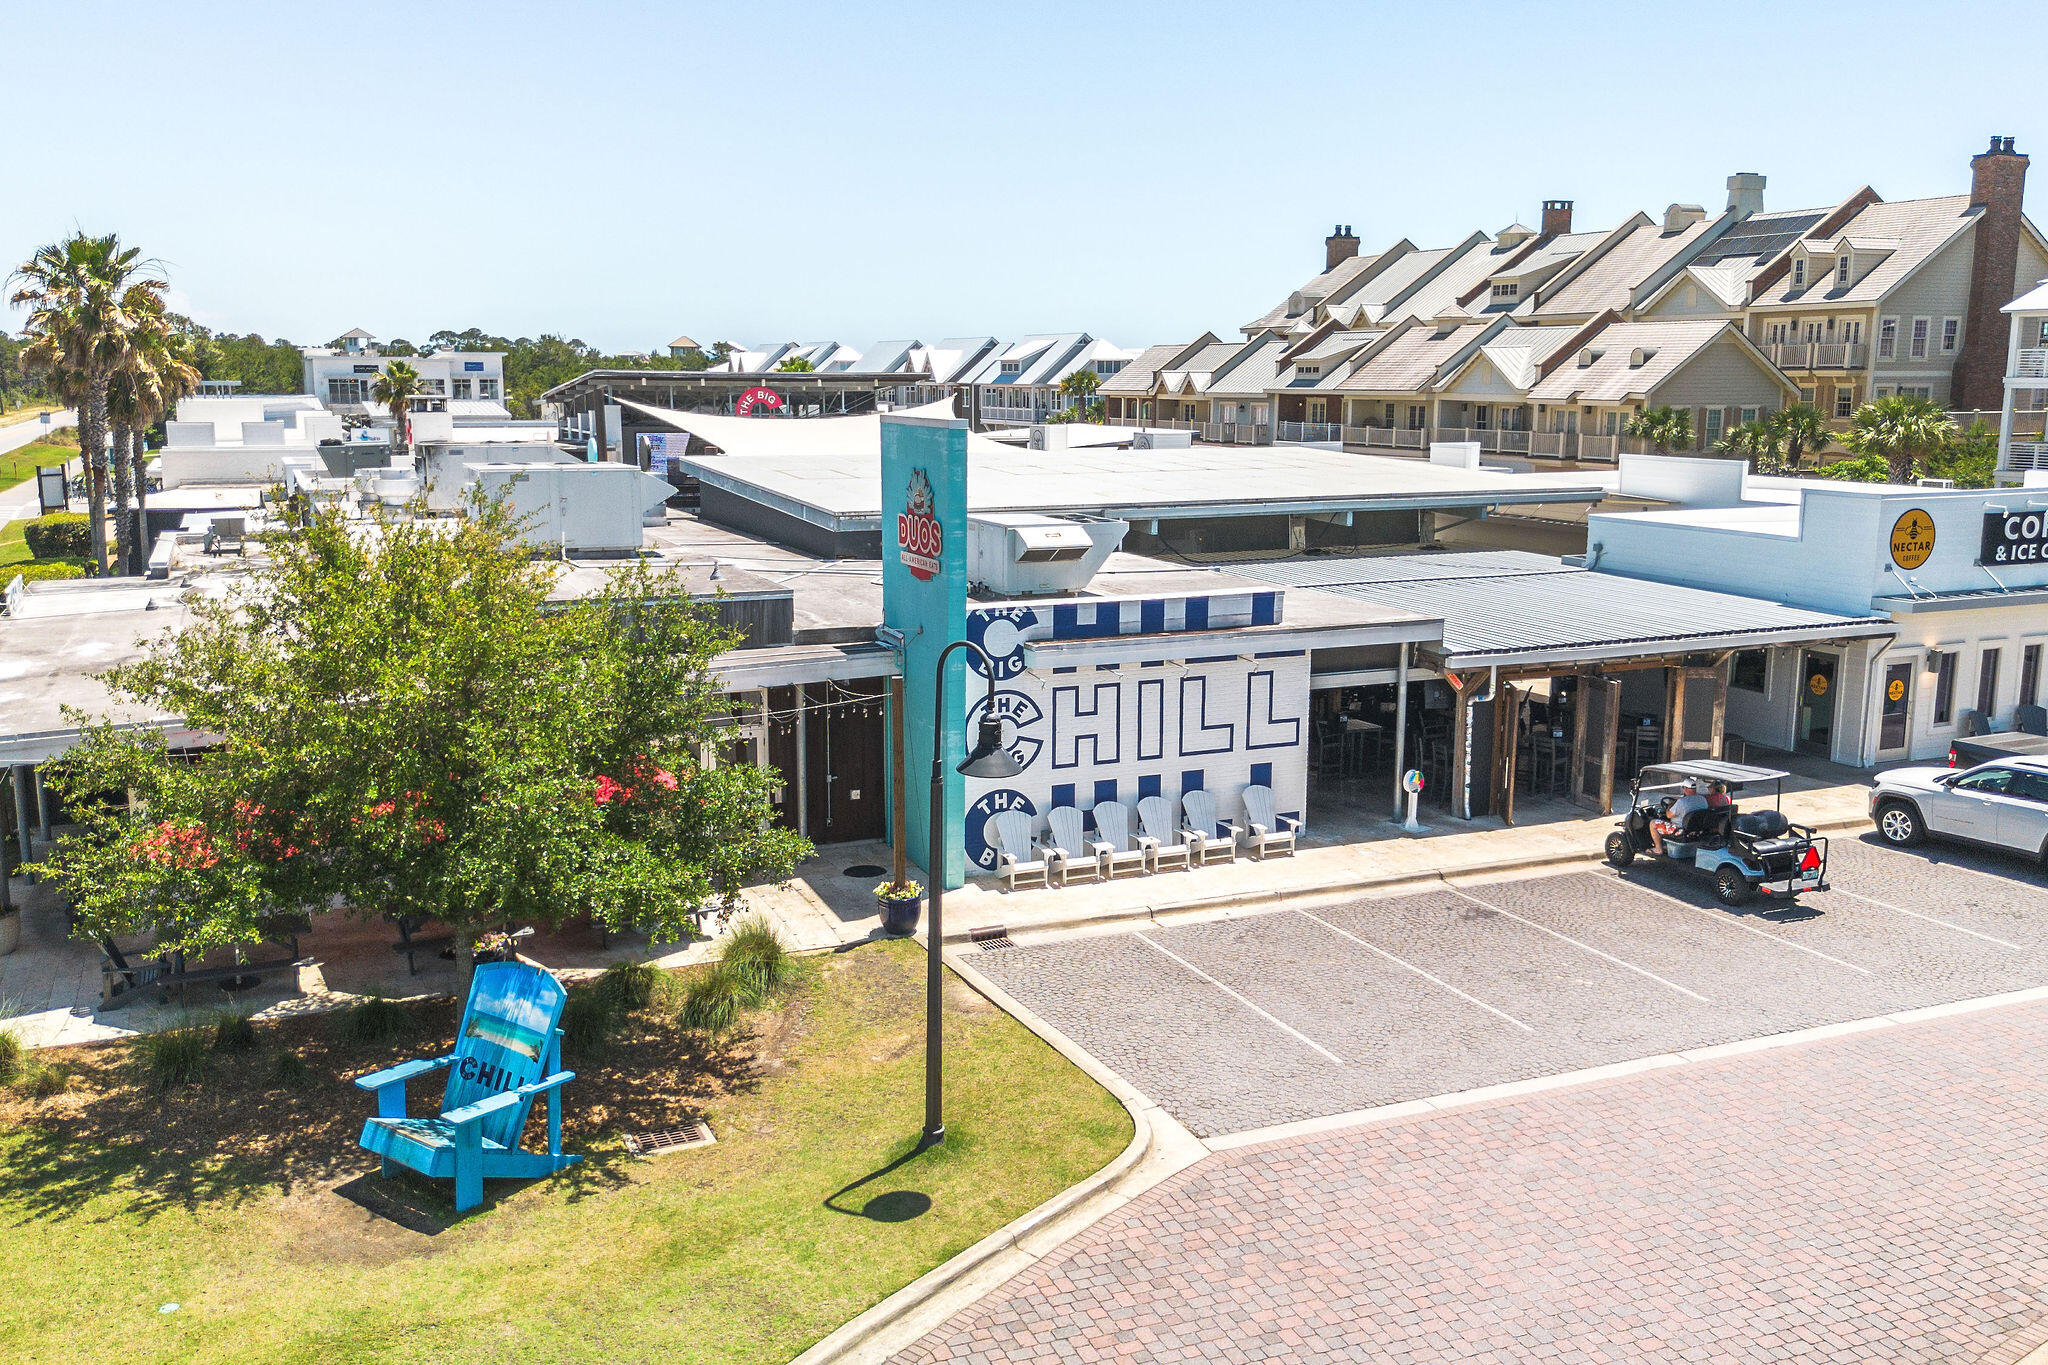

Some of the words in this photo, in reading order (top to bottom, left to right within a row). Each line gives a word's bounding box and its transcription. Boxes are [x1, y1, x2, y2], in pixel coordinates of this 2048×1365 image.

[740, 394, 754, 415] THE
[757, 390, 776, 405] BIG
[898, 513, 941, 557] DUOS
[1893, 541, 1931, 553] NECTAR
[1902, 554, 1920, 562] COFFEE
[1995, 545, 2007, 562] &
[2010, 544, 2038, 561] ICE
[965, 671, 1300, 774] CHILL
[976, 792, 1026, 815] THE
